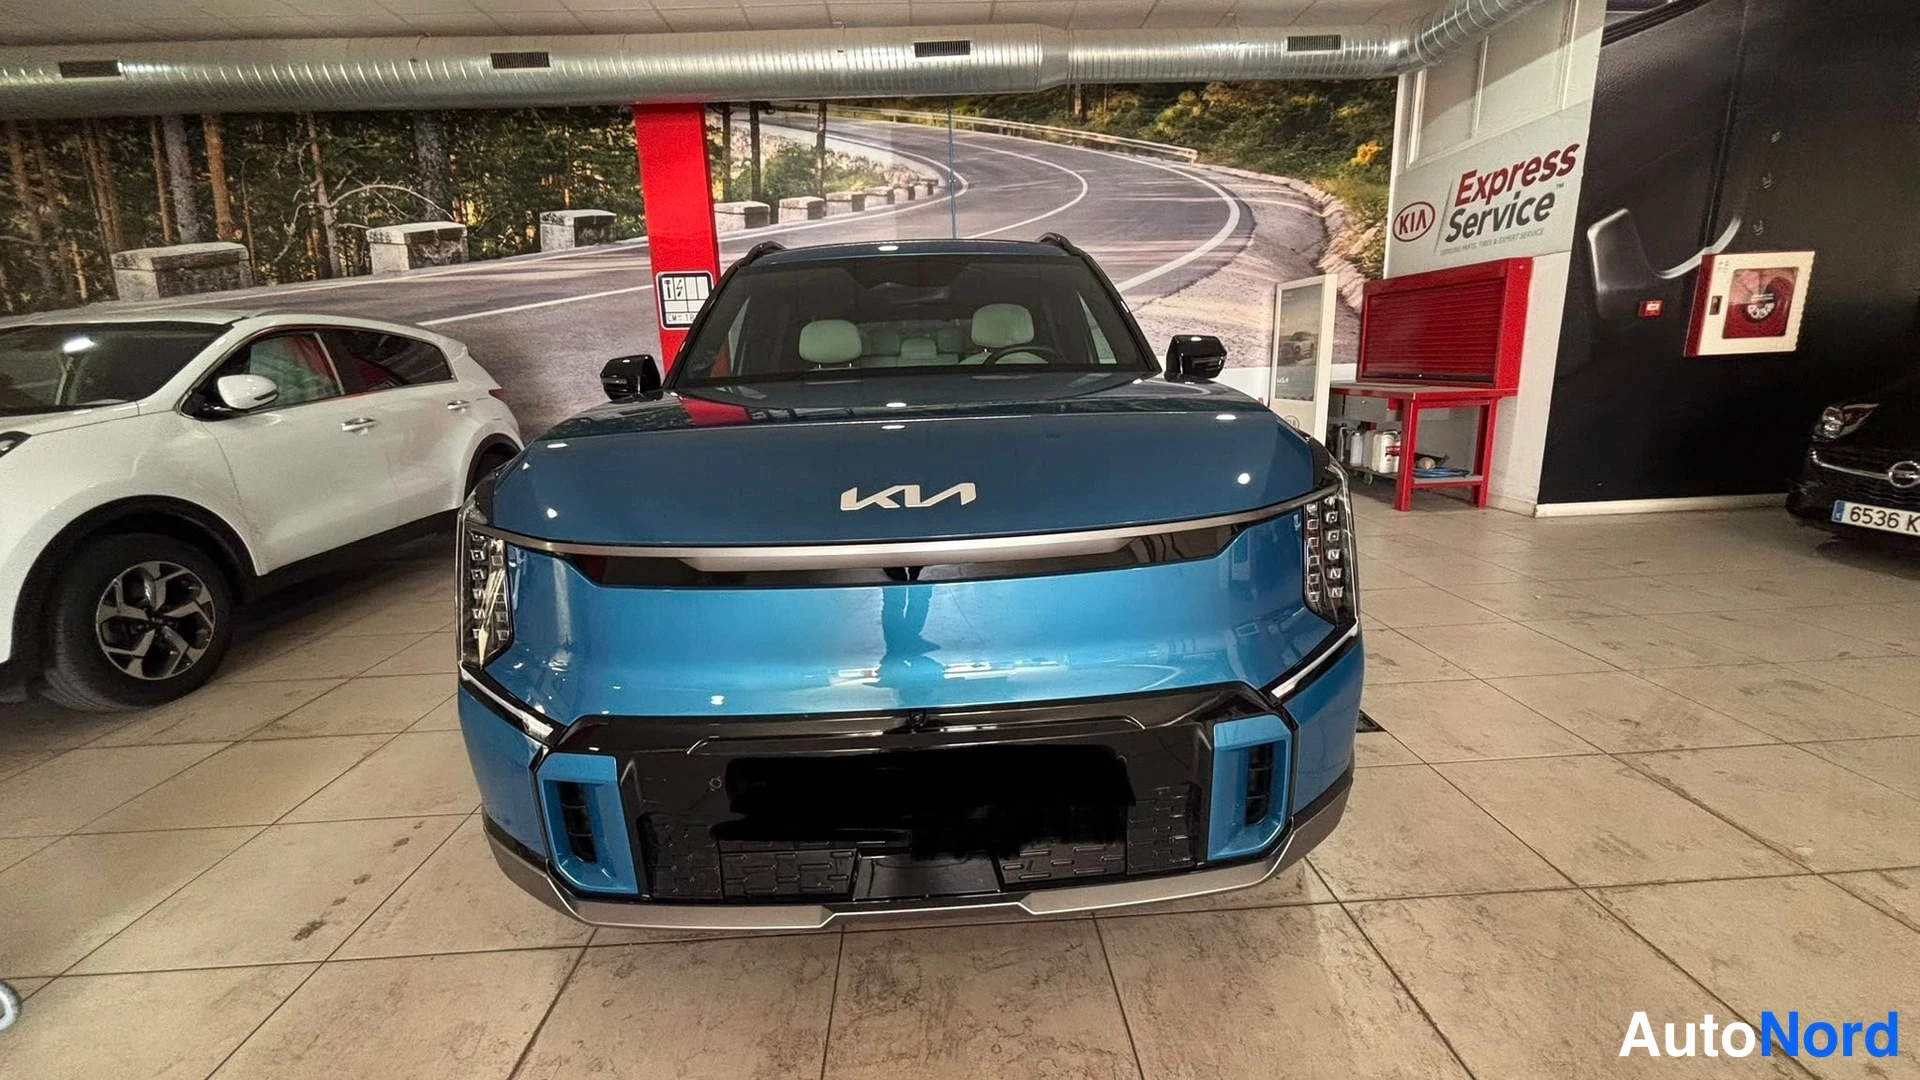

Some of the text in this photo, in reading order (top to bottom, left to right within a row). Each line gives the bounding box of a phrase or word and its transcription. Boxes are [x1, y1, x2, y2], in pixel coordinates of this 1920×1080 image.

[1454, 143, 1580, 208] Express
[1399, 209, 1428, 236] KIA
[1445, 191, 1556, 243] Service
[840, 482, 977, 511] KIA
[1850, 506, 1920, 533] 6536 K
